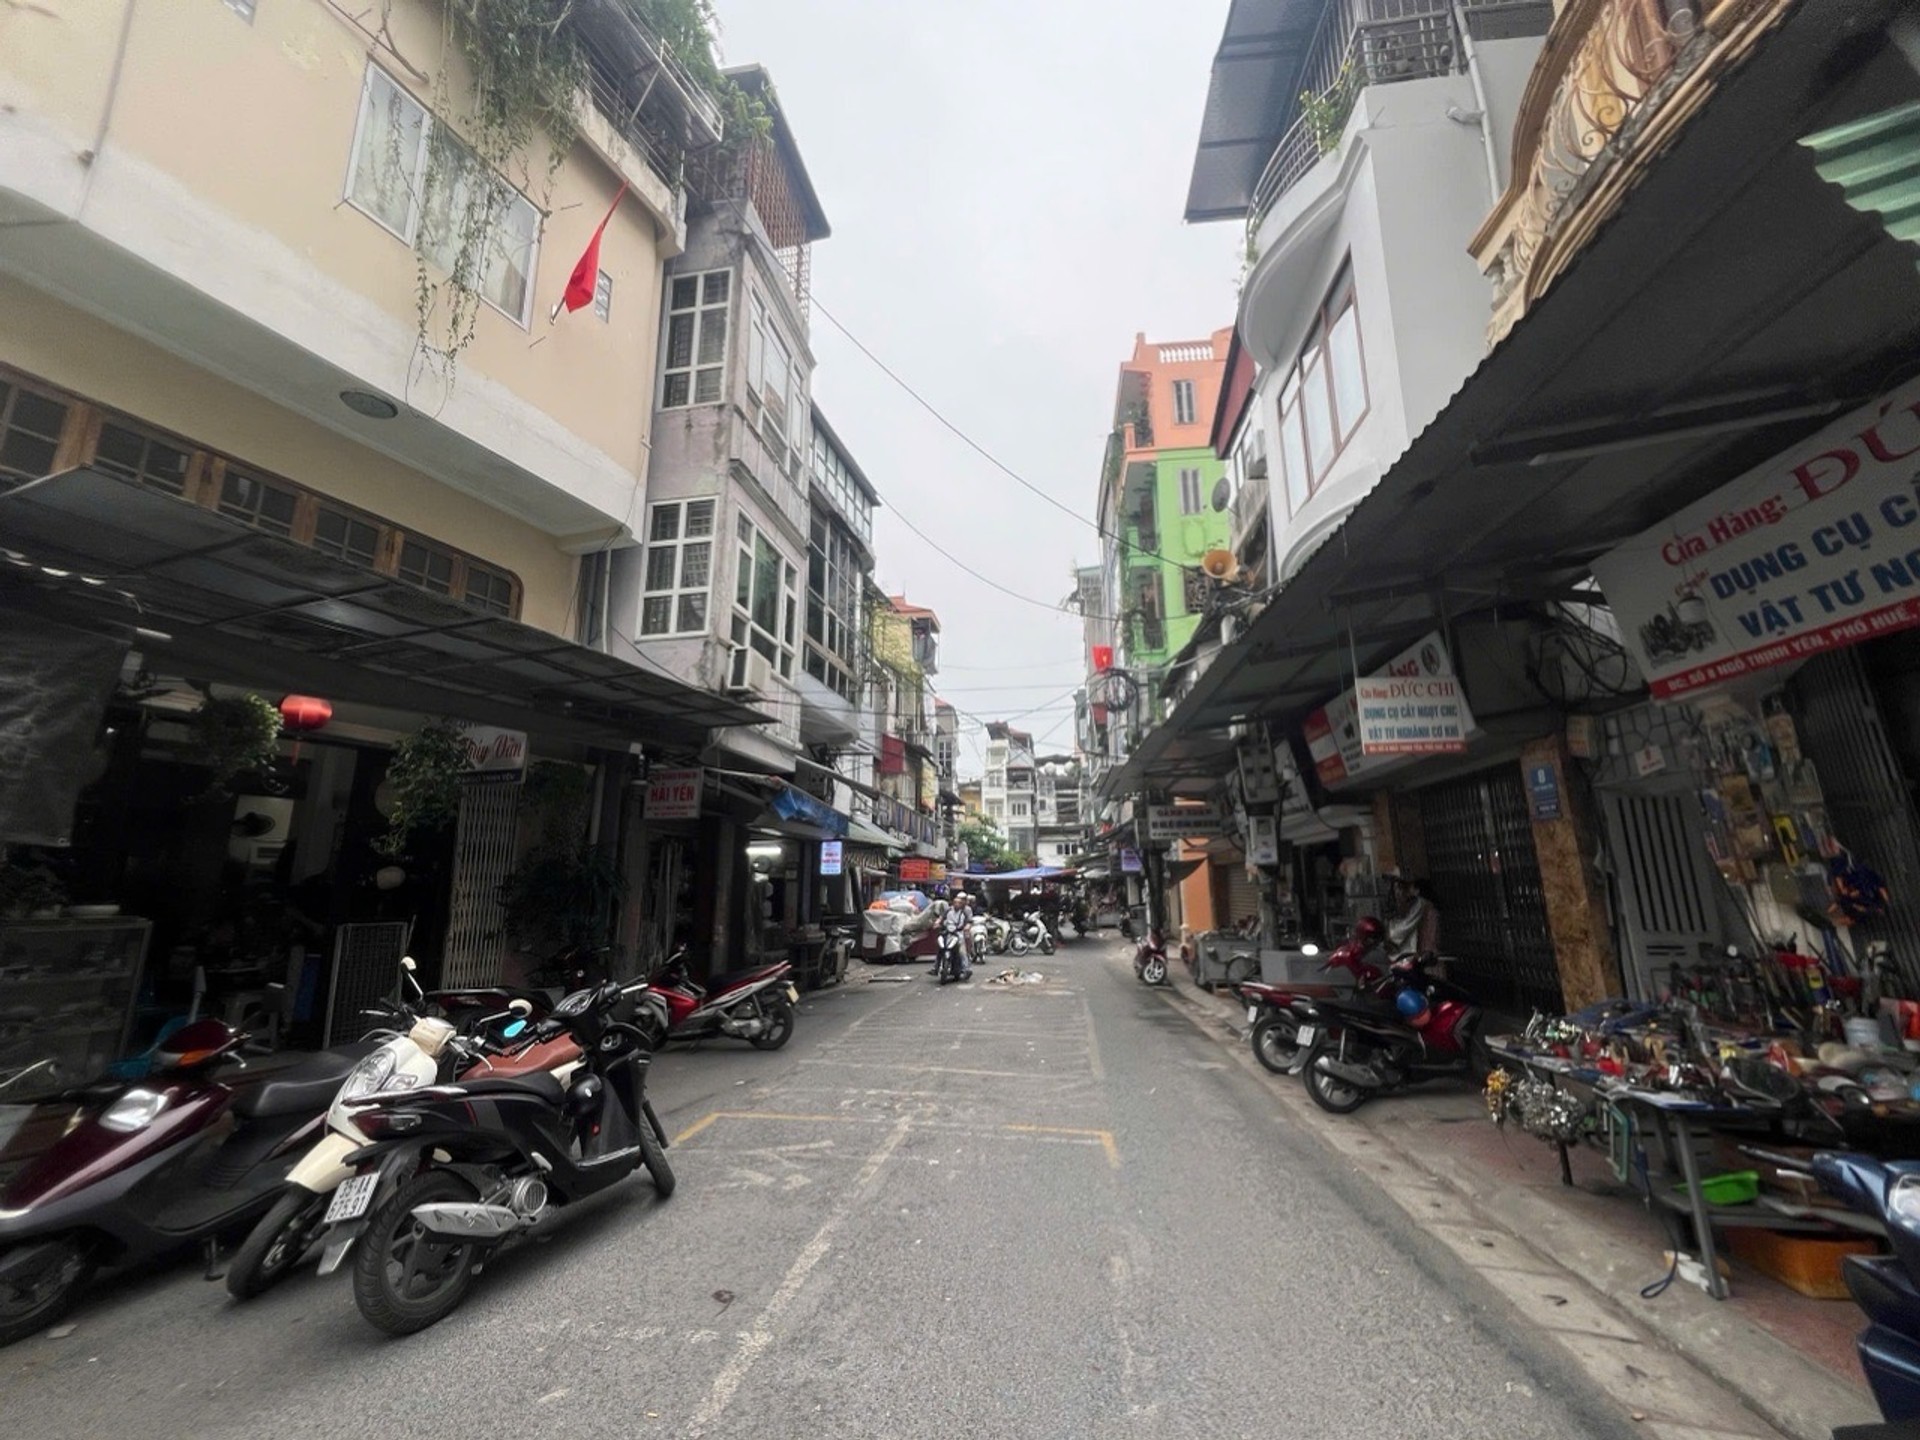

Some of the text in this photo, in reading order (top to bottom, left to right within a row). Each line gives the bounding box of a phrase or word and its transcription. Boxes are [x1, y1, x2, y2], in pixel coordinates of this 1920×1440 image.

[1661, 529, 1707, 566] Cửa
[1707, 494, 1788, 546] Hàng:
[1710, 542, 1808, 599] DỤNG
[1812, 512, 1872, 556] CỤ
[1738, 596, 1804, 637] VẬT
[1808, 569, 1865, 613] TƯ
[1831, 618, 1868, 641] PHỐ
[1390, 679, 1424, 698] ĐỨC
[1427, 682, 1455, 697] CHI
